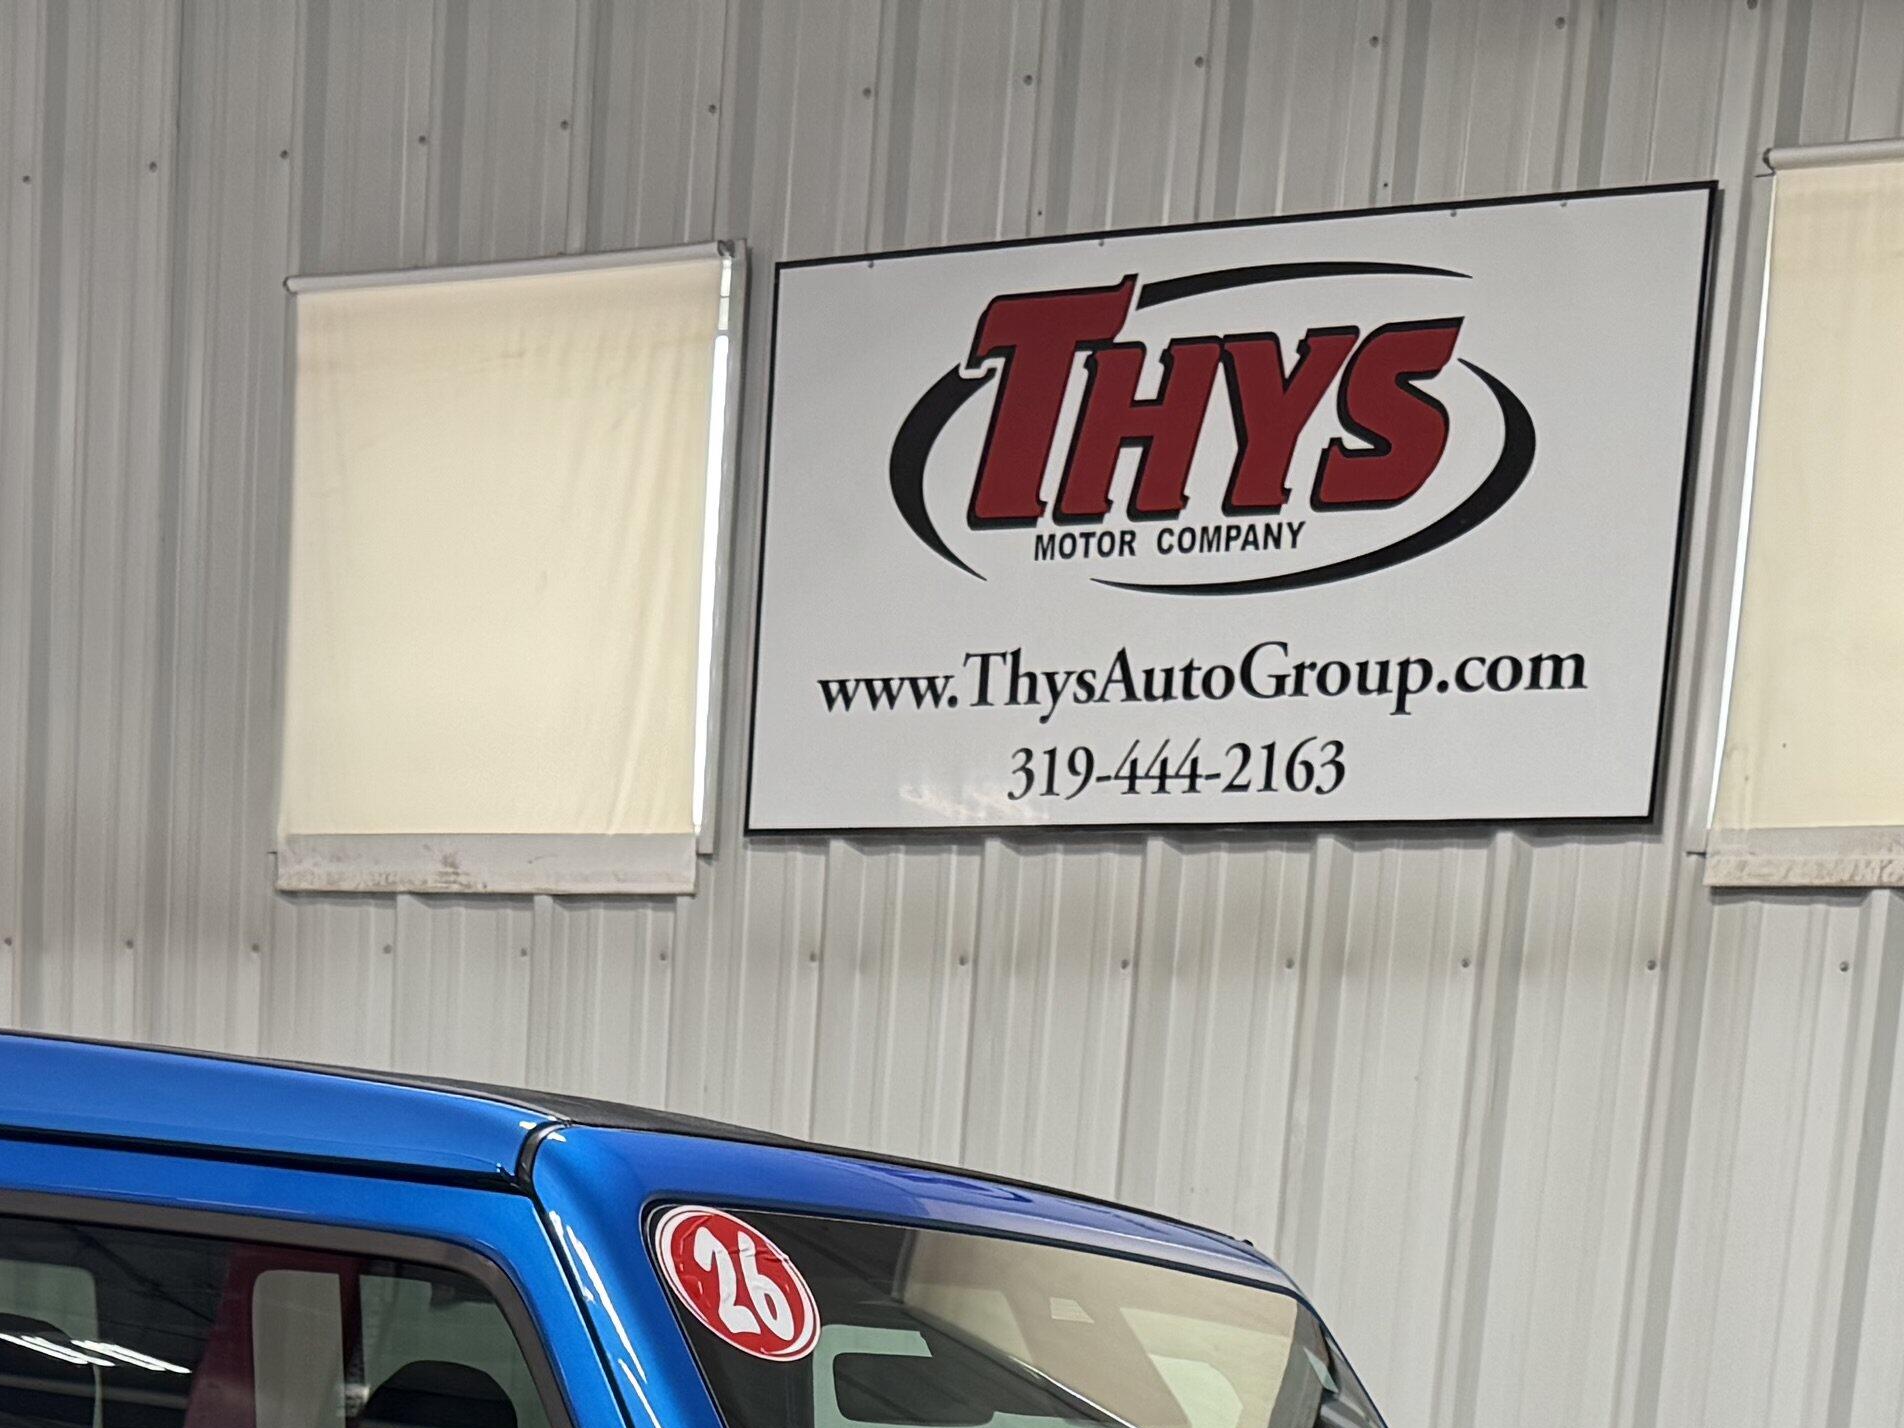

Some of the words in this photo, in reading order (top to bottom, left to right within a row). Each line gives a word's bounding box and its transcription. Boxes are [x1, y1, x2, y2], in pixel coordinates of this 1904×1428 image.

[958, 272, 1465, 530] THYS
[1033, 529, 1137, 562] MOTOR
[1156, 519, 1306, 554] COMPANY
[816, 640, 1589, 725] www.ThysAutoGroup.com
[1007, 736, 1346, 801] 319-444-2163
[692, 1225, 796, 1342] 26
